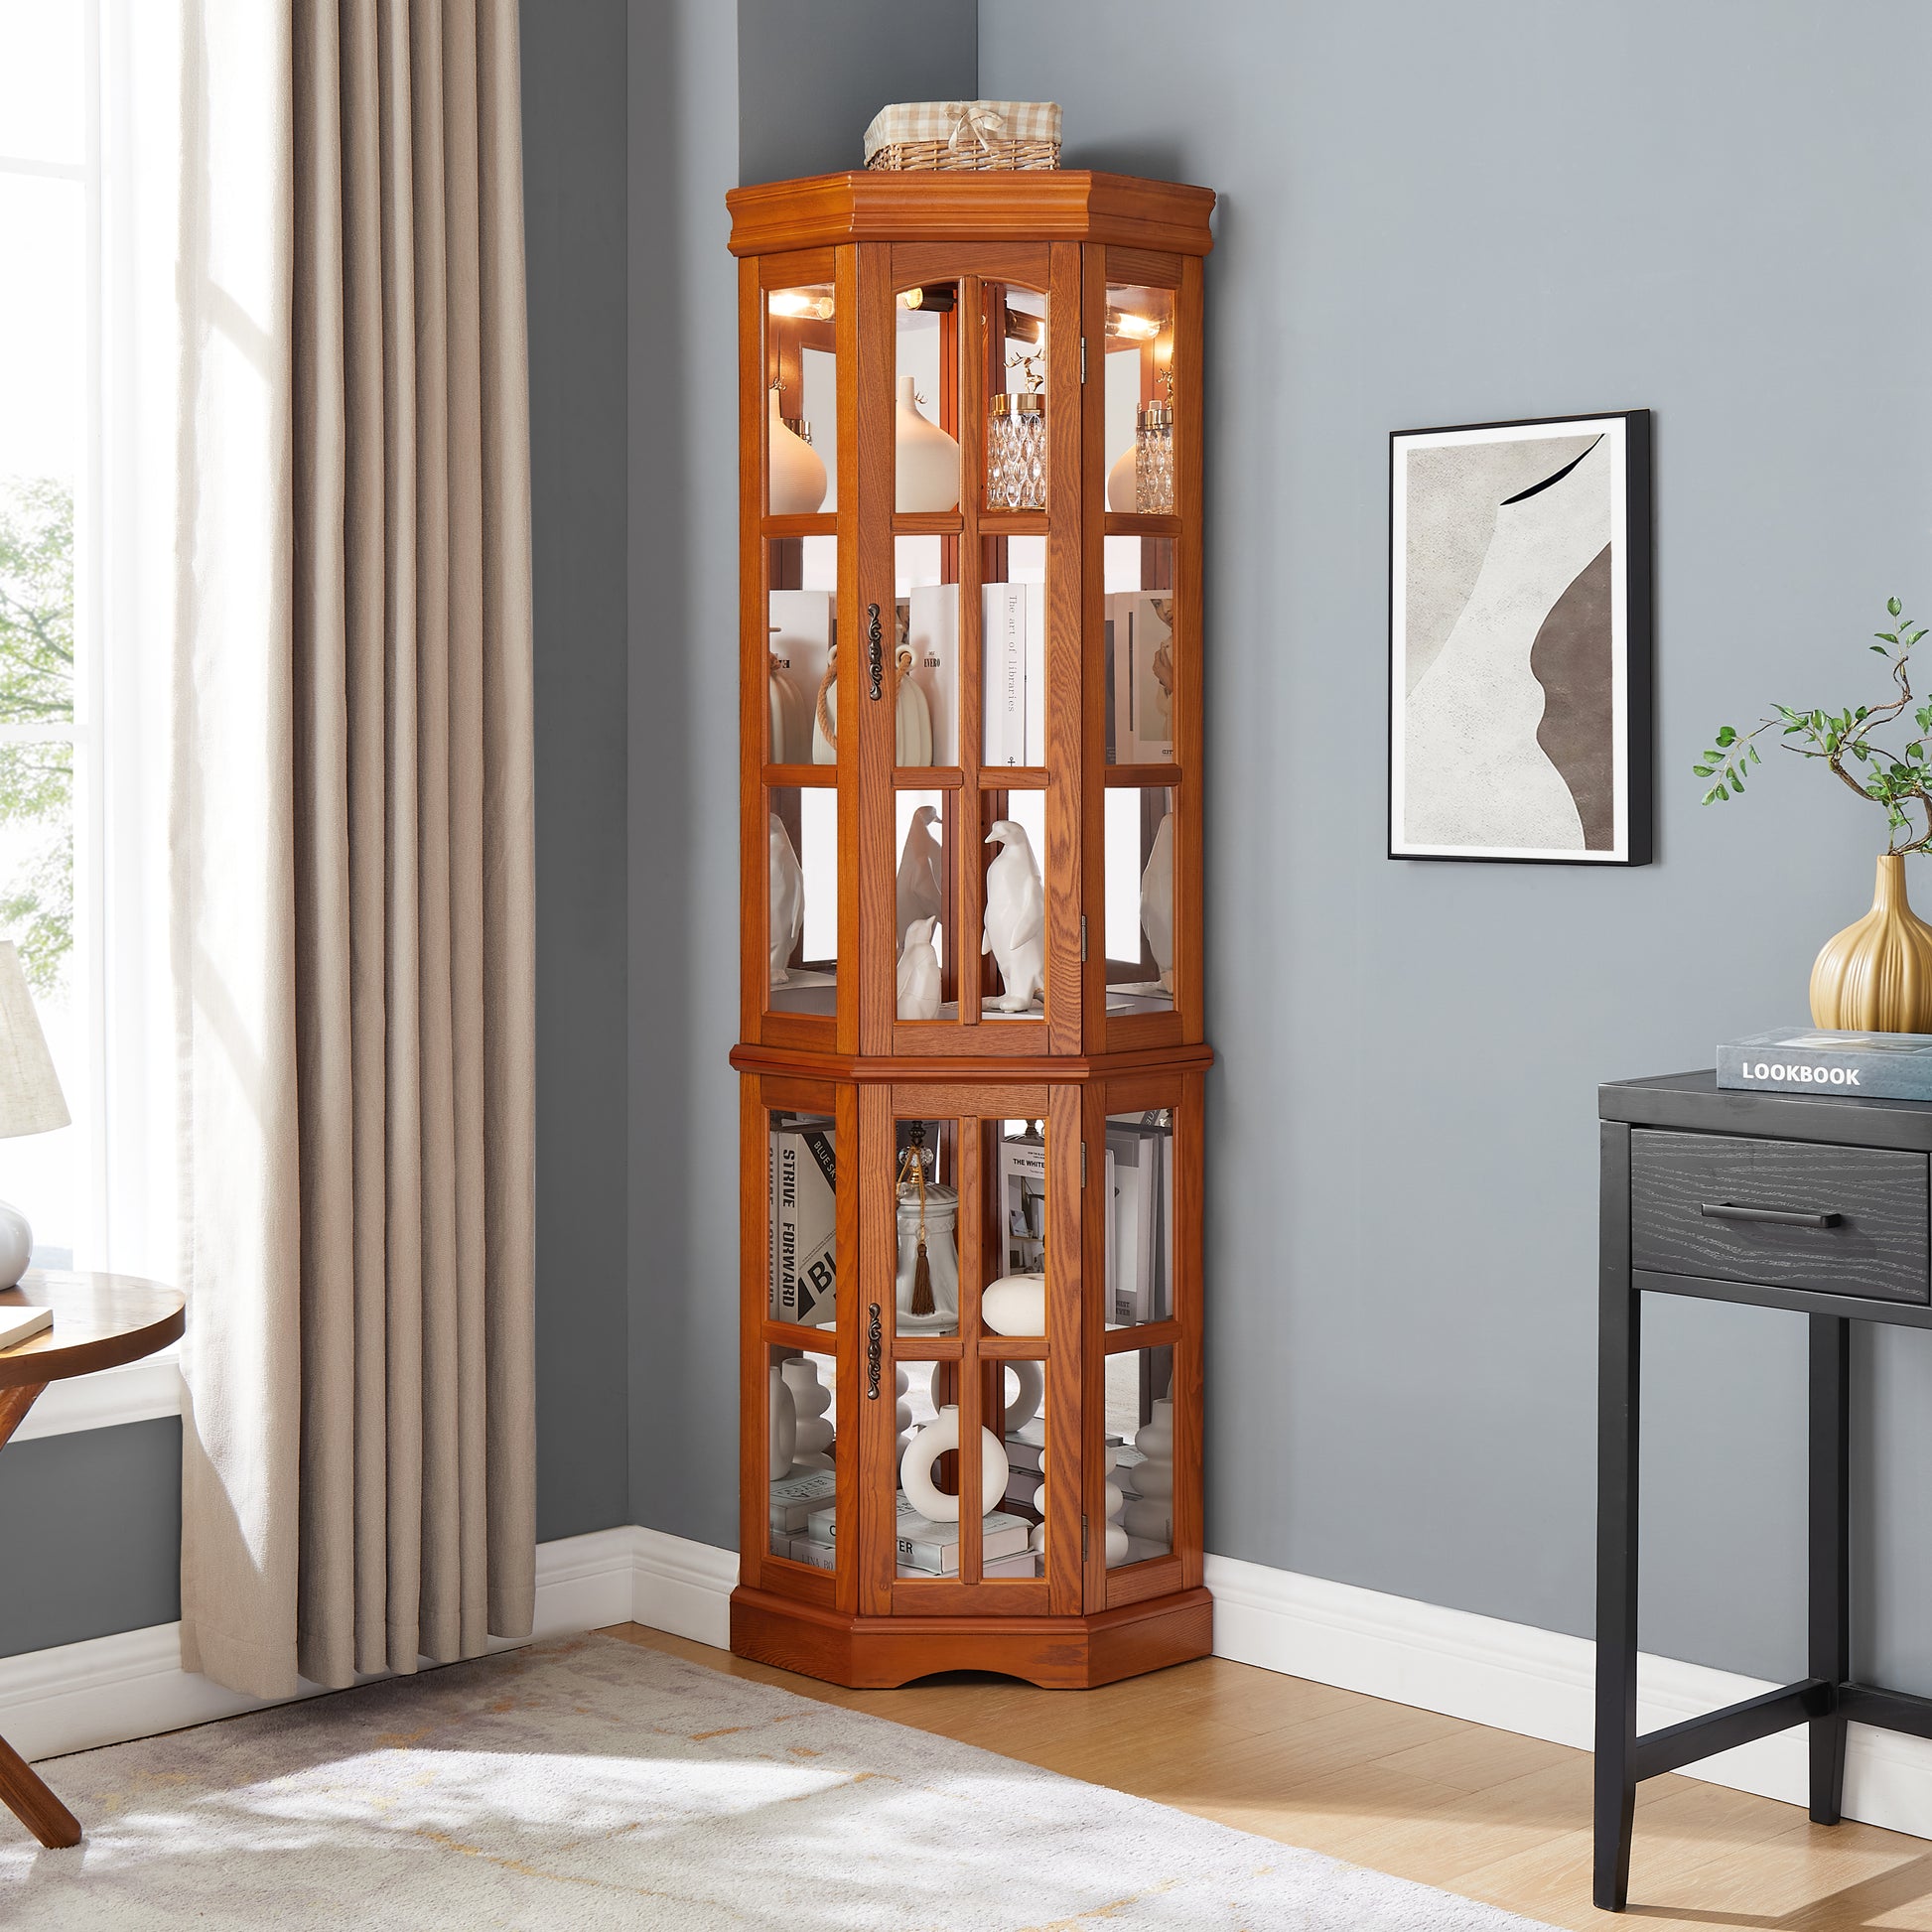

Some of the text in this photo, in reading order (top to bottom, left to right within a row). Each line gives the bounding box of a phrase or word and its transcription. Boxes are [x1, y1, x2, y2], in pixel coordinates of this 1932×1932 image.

[1009, 596, 1018, 613] The
[1009, 641, 1018, 654] of
[1009, 660, 1018, 713] libraries
[1742, 1062, 1861, 1086] LOOKBOOK
[813, 1140, 829, 1166] BLUE
[1013, 1158, 1026, 1167] THE
[1026, 1160, 1045, 1169] WHITE
[782, 1149, 795, 1308] STRIVE FORWARD
